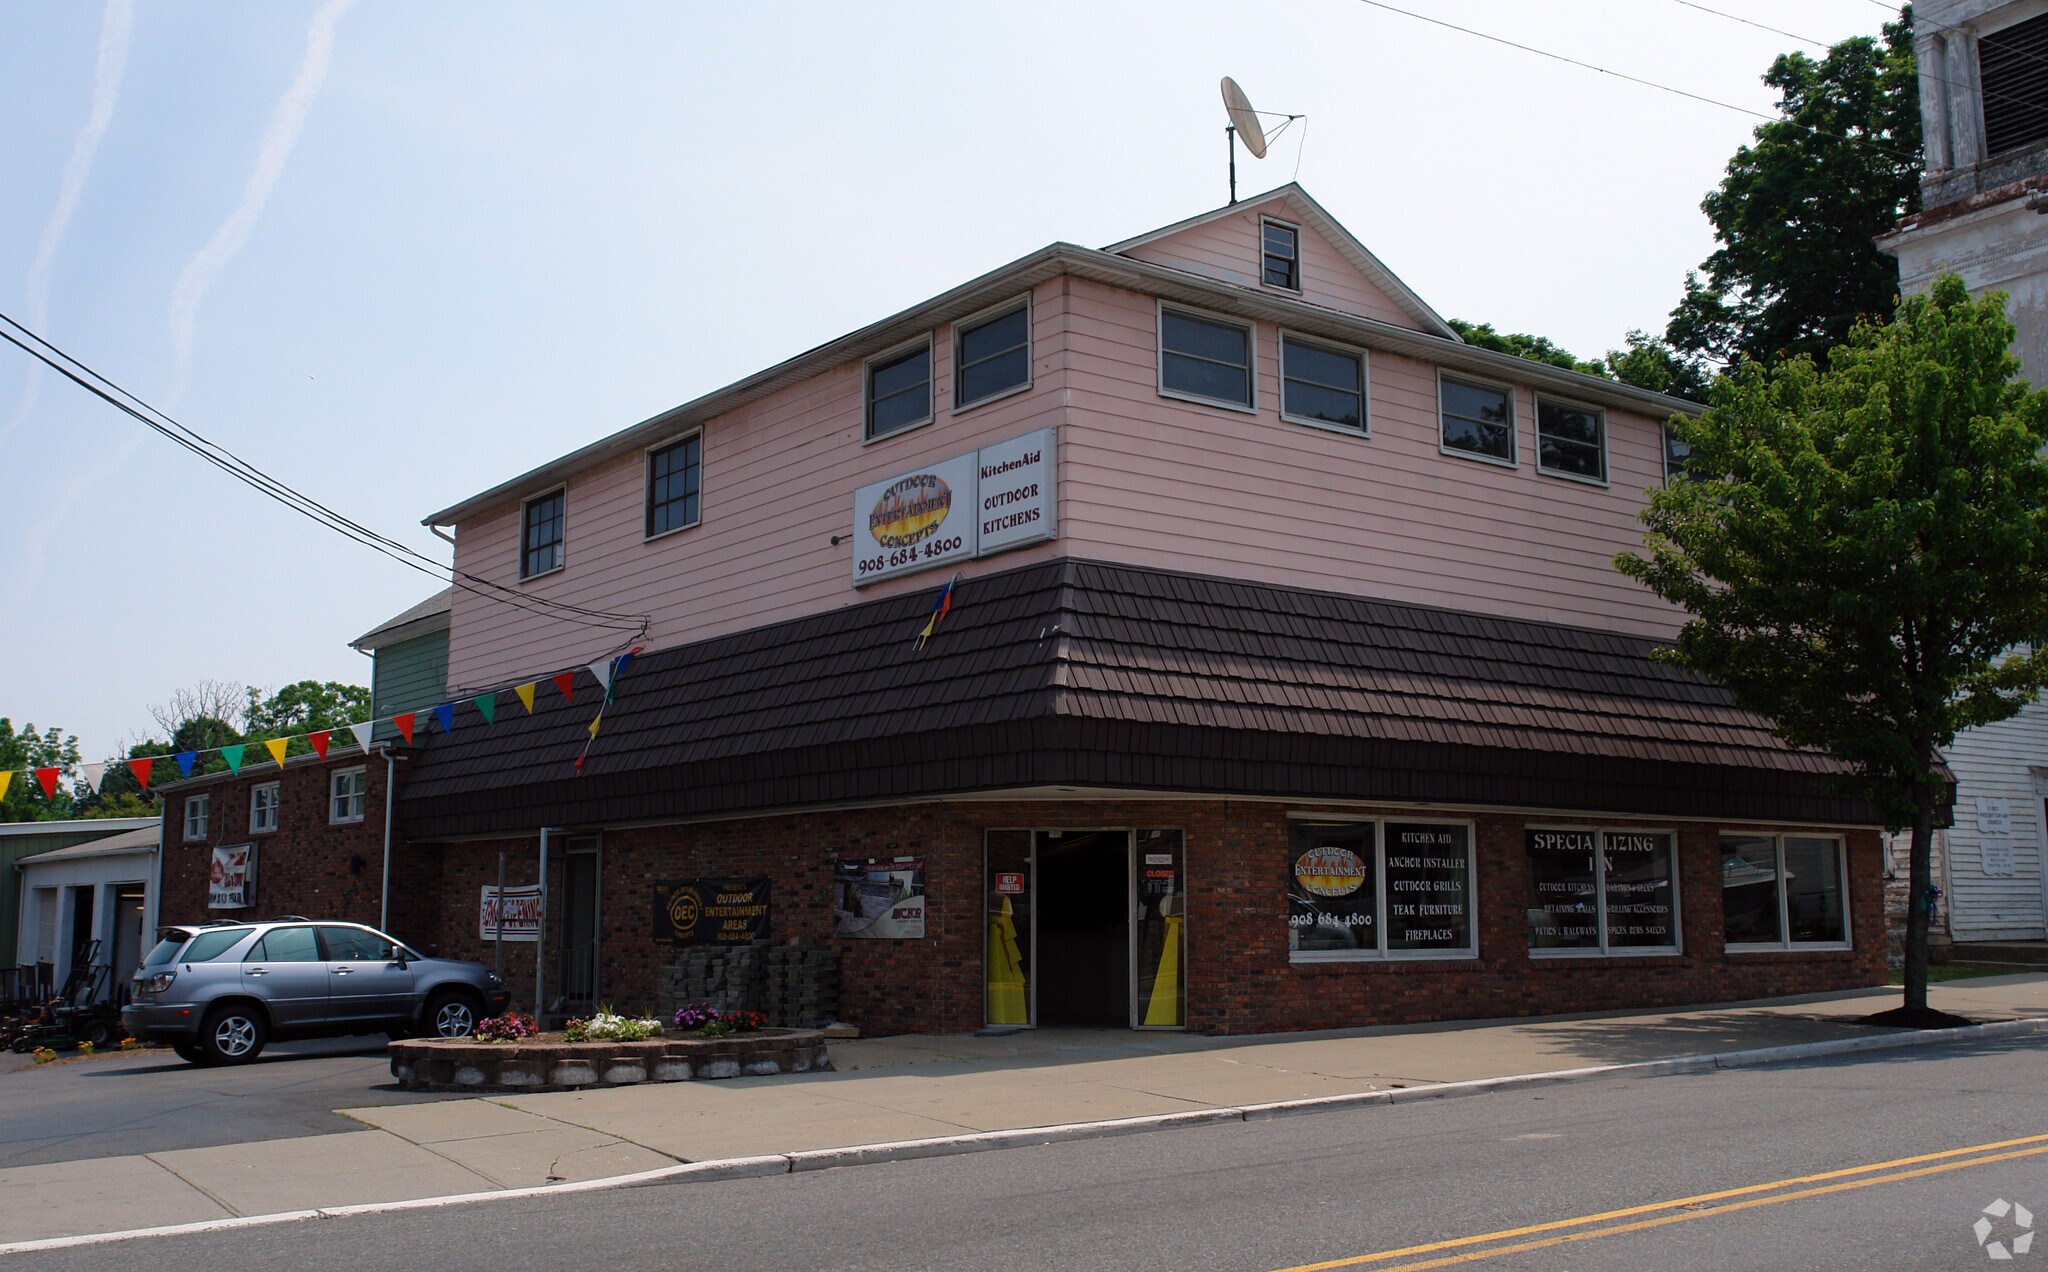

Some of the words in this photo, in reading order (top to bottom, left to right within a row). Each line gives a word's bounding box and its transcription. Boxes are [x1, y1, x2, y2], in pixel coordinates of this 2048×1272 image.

[981, 451, 1041, 479] KitchenAid
[883, 474, 937, 501] OUTDOOR
[984, 483, 1039, 510] OUTDOOR
[869, 489, 952, 530] ENTERTAINMENT
[983, 507, 1040, 535] KITCHENS
[880, 520, 939, 549] CONCEPTS
[859, 536, 962, 576] 908-684-4800
[1401, 832, 1435, 844] KITCHEN
[1438, 833, 1452, 844] AID
[1534, 833, 1654, 852] SPECIALIZING
[1307, 847, 1354, 860] OUTDOOR
[1388, 857, 1421, 868] ANCHOR
[1423, 858, 1466, 869] INSTALLER
[1588, 856, 1614, 872] IN
[1295, 864, 1367, 878] ENTERTAINMENT
[1002, 875, 1017, 883] HELP
[999, 883, 1020, 891] WANTED
[1305, 883, 1357, 897] CONCEPTS
[1393, 880, 1431, 892] OUTDOOR
[1433, 880, 1461, 892] GRILLS
[716, 892, 753, 904] OUTDOOR
[674, 905, 695, 920] OEC
[705, 904, 767, 917] ENTERTAINMENT
[891, 907, 921, 920] ANCHOR
[1392, 904, 1415, 915] TEAK
[1419, 904, 1463, 917] FURNITURE
[722, 920, 748, 930] AREAS
[1405, 929, 1453, 942] FIREPLACES
